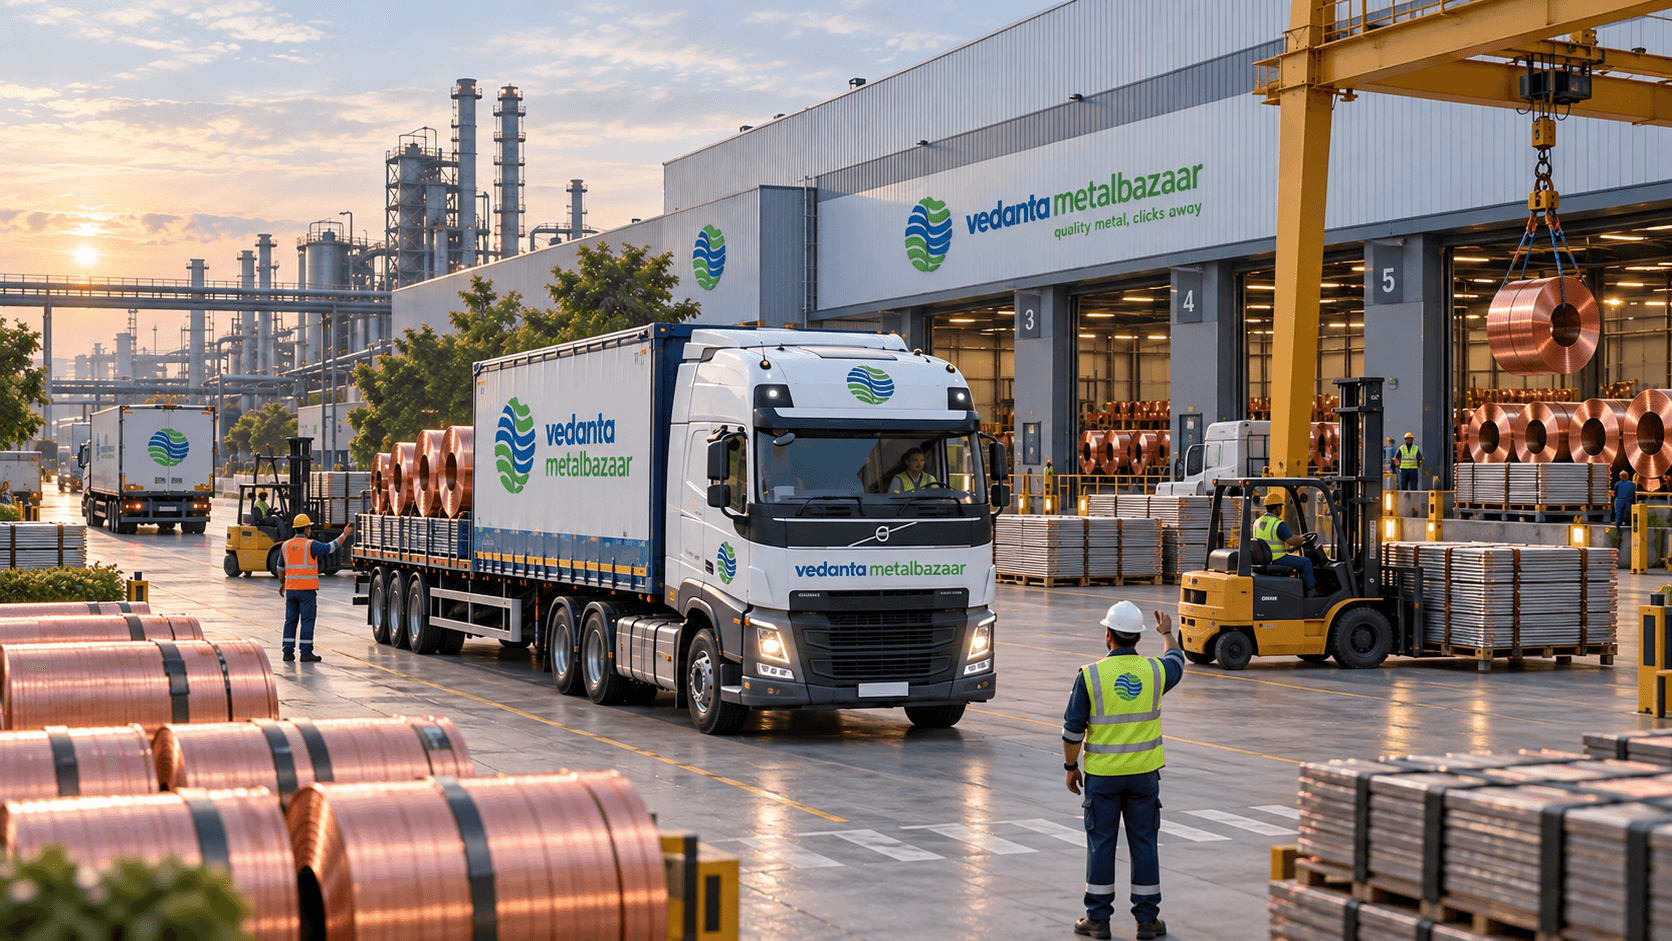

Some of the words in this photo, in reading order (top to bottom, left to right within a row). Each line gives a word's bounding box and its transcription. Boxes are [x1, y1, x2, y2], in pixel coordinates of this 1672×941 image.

[966, 194, 1050, 234] vedanta
[1053, 163, 1203, 217] metalbazaar
[1054, 221, 1092, 241] quality
[1095, 212, 1130, 231] metal,
[1133, 207, 1165, 224] clicks
[1169, 203, 1202, 217] away
[1382, 267, 1396, 293] 5
[1183, 290, 1195, 312] 4
[1025, 308, 1034, 330] 3
[545, 412, 615, 446] vedanta
[545, 450, 633, 477] metalbazaar
[795, 561, 867, 577] vedanta
[869, 560, 967, 577] metalbazaar
